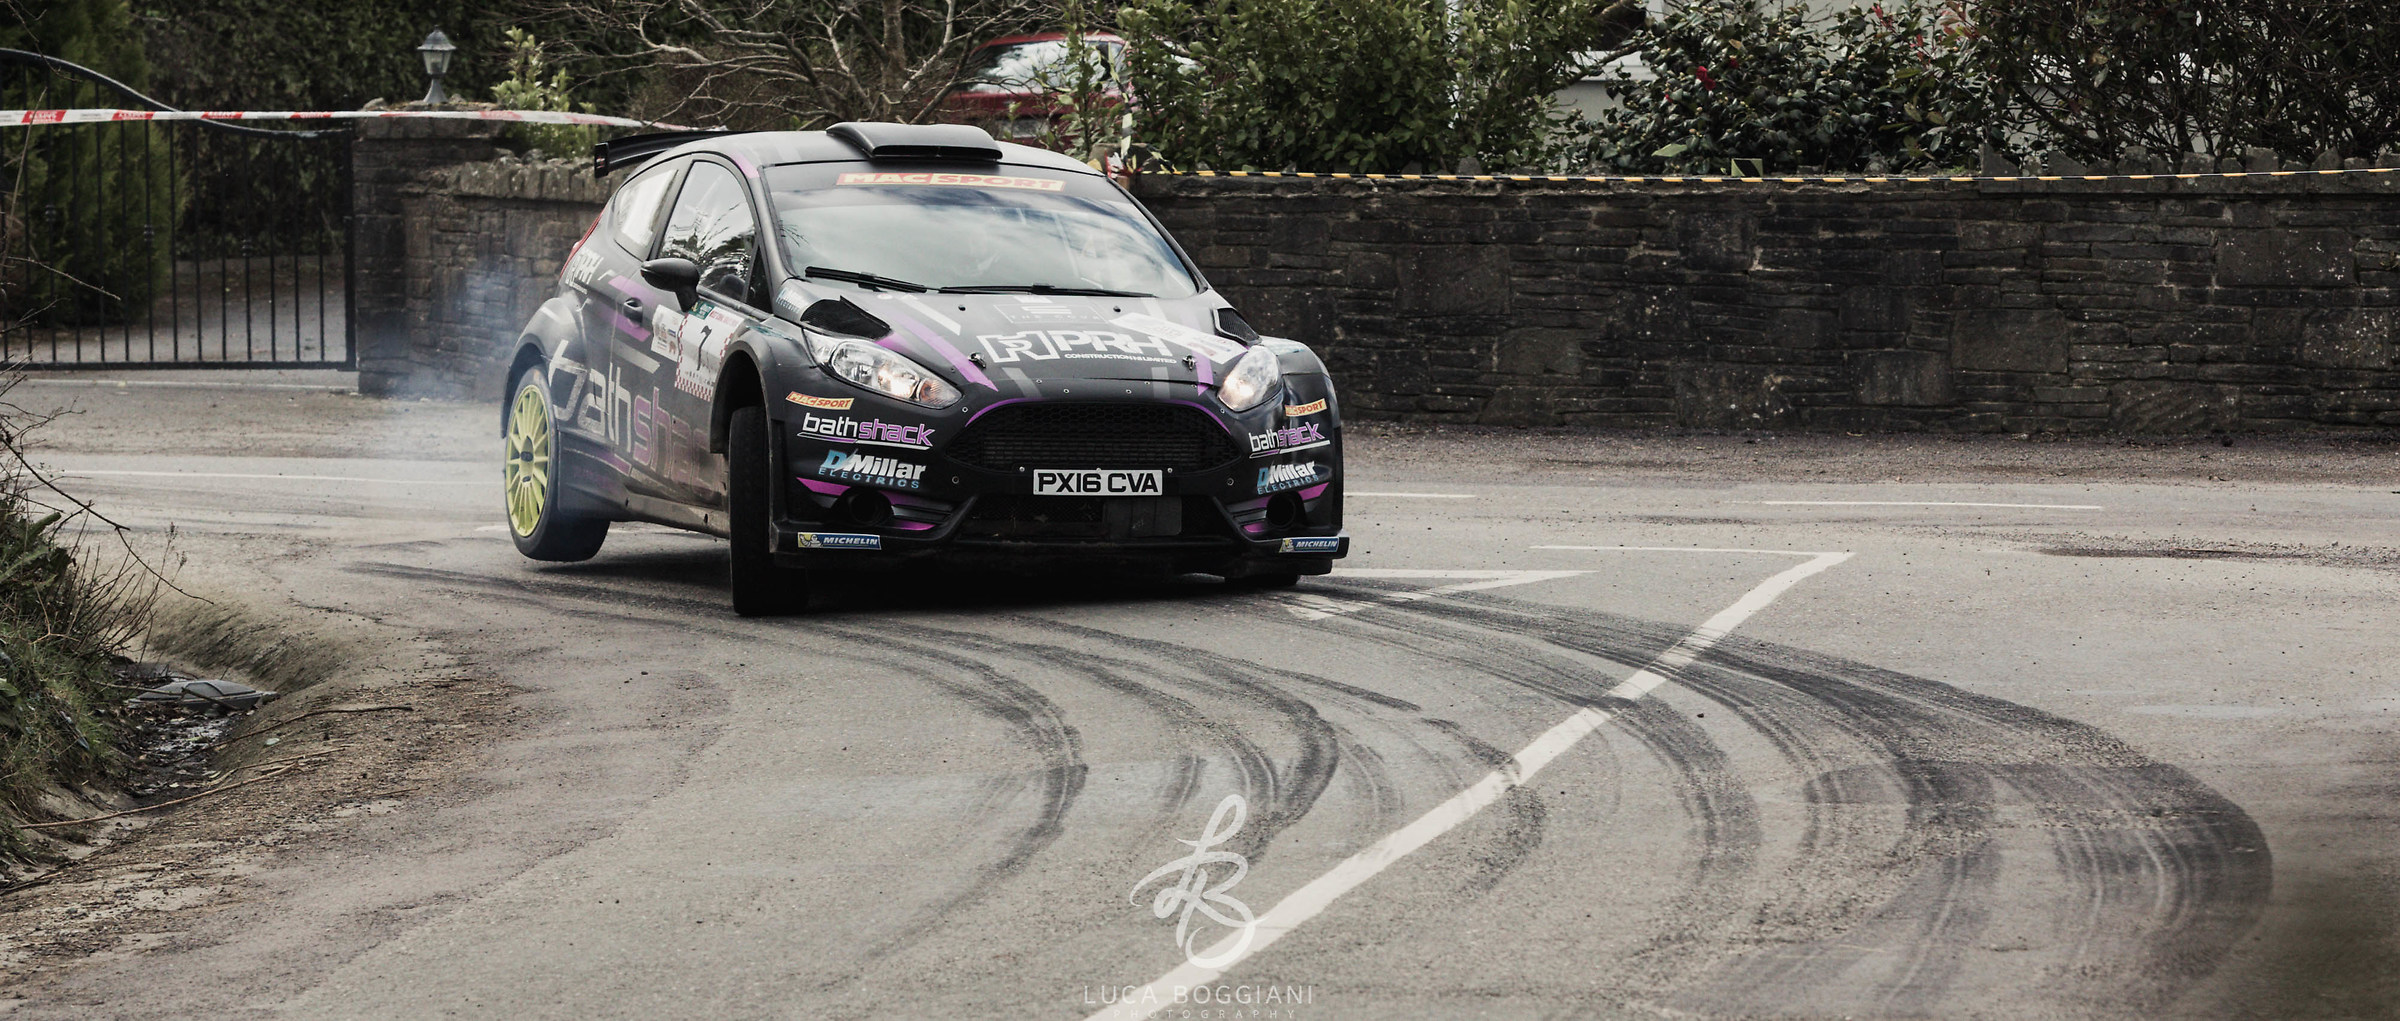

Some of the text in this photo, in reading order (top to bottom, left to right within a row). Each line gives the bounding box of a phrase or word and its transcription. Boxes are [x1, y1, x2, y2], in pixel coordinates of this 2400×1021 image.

[844, 173, 1058, 189] MAC SPORT
[697, 325, 712, 371] 7
[1049, 330, 1173, 356] PRH
[816, 399, 850, 408] SPORT
[802, 412, 935, 446] bathshack
[1249, 421, 1326, 452] bathshack
[818, 468, 920, 488] ELECTRICS
[1038, 473, 1159, 493] PX16 CVA
[1257, 475, 1319, 495] ELECTRICS
[823, 536, 878, 545] MICHELIN
[1295, 539, 1338, 548] MICHELIN
